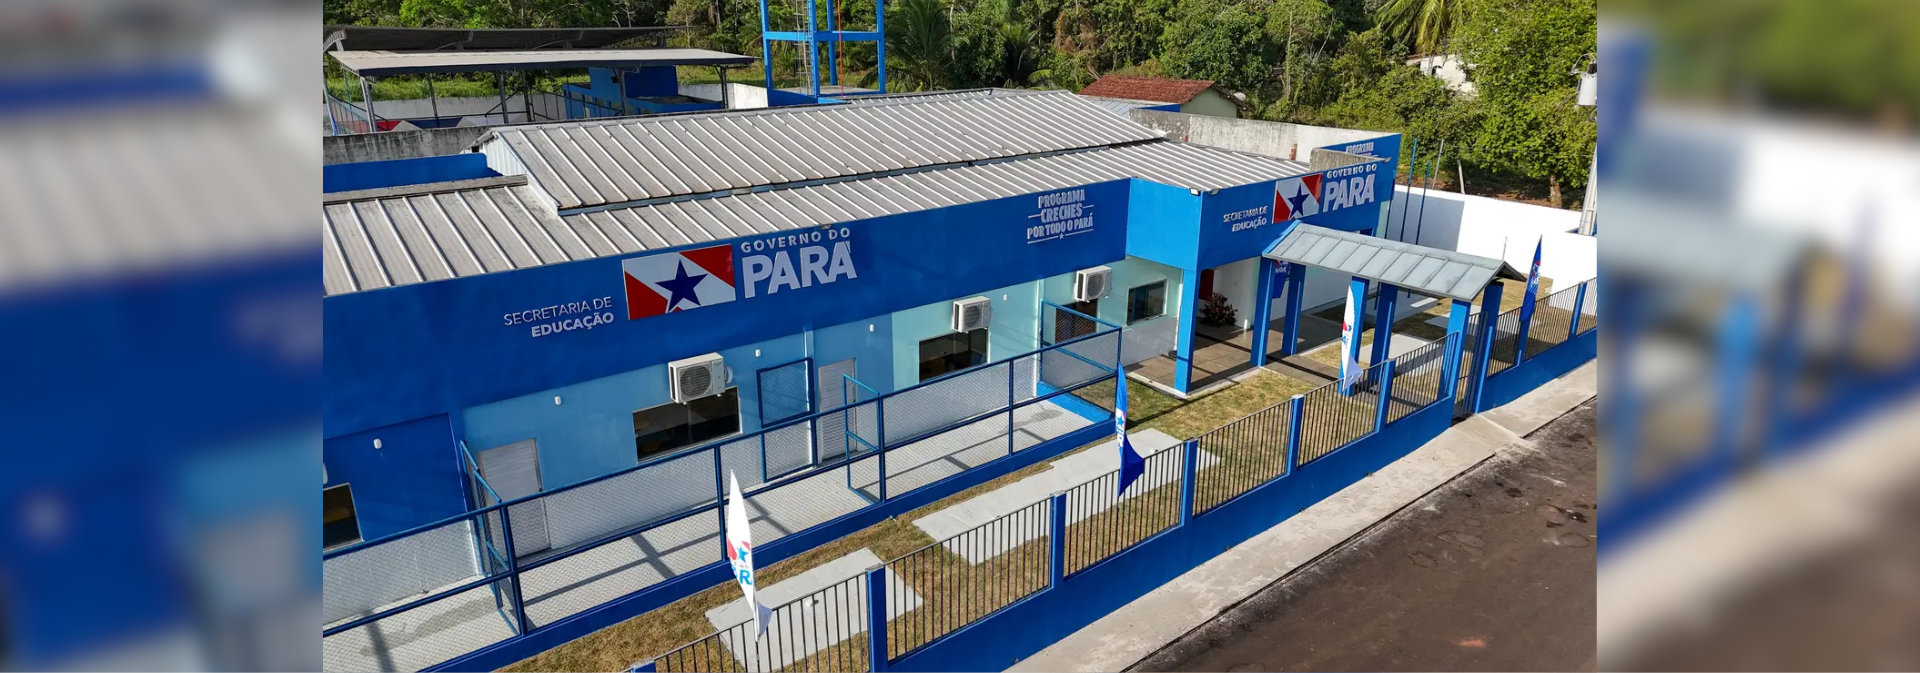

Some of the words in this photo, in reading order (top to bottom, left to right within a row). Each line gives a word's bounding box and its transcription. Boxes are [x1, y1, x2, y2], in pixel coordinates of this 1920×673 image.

[1327, 163, 1364, 179] GOVERNO
[1366, 163, 1377, 172] DO
[1038, 189, 1085, 209] PROGRAMA
[1041, 202, 1083, 223] CRECHES
[1223, 208, 1258, 222] SECRETARIA
[1259, 205, 1268, 214] DE
[1232, 216, 1267, 232] EDUCAÇÃO
[1027, 225, 1045, 239] POR
[1045, 221, 1067, 235] TODO
[1067, 220, 1073, 231] O
[1074, 212, 1093, 230] PARÁ
[740, 231, 821, 253] GOVERNO
[828, 227, 851, 240] DO
[741, 240, 858, 298] PARÁ
[504, 300, 591, 326] SECRETARIA
[593, 296, 612, 309] DE
[531, 312, 615, 337] EDUCAÇÃO
